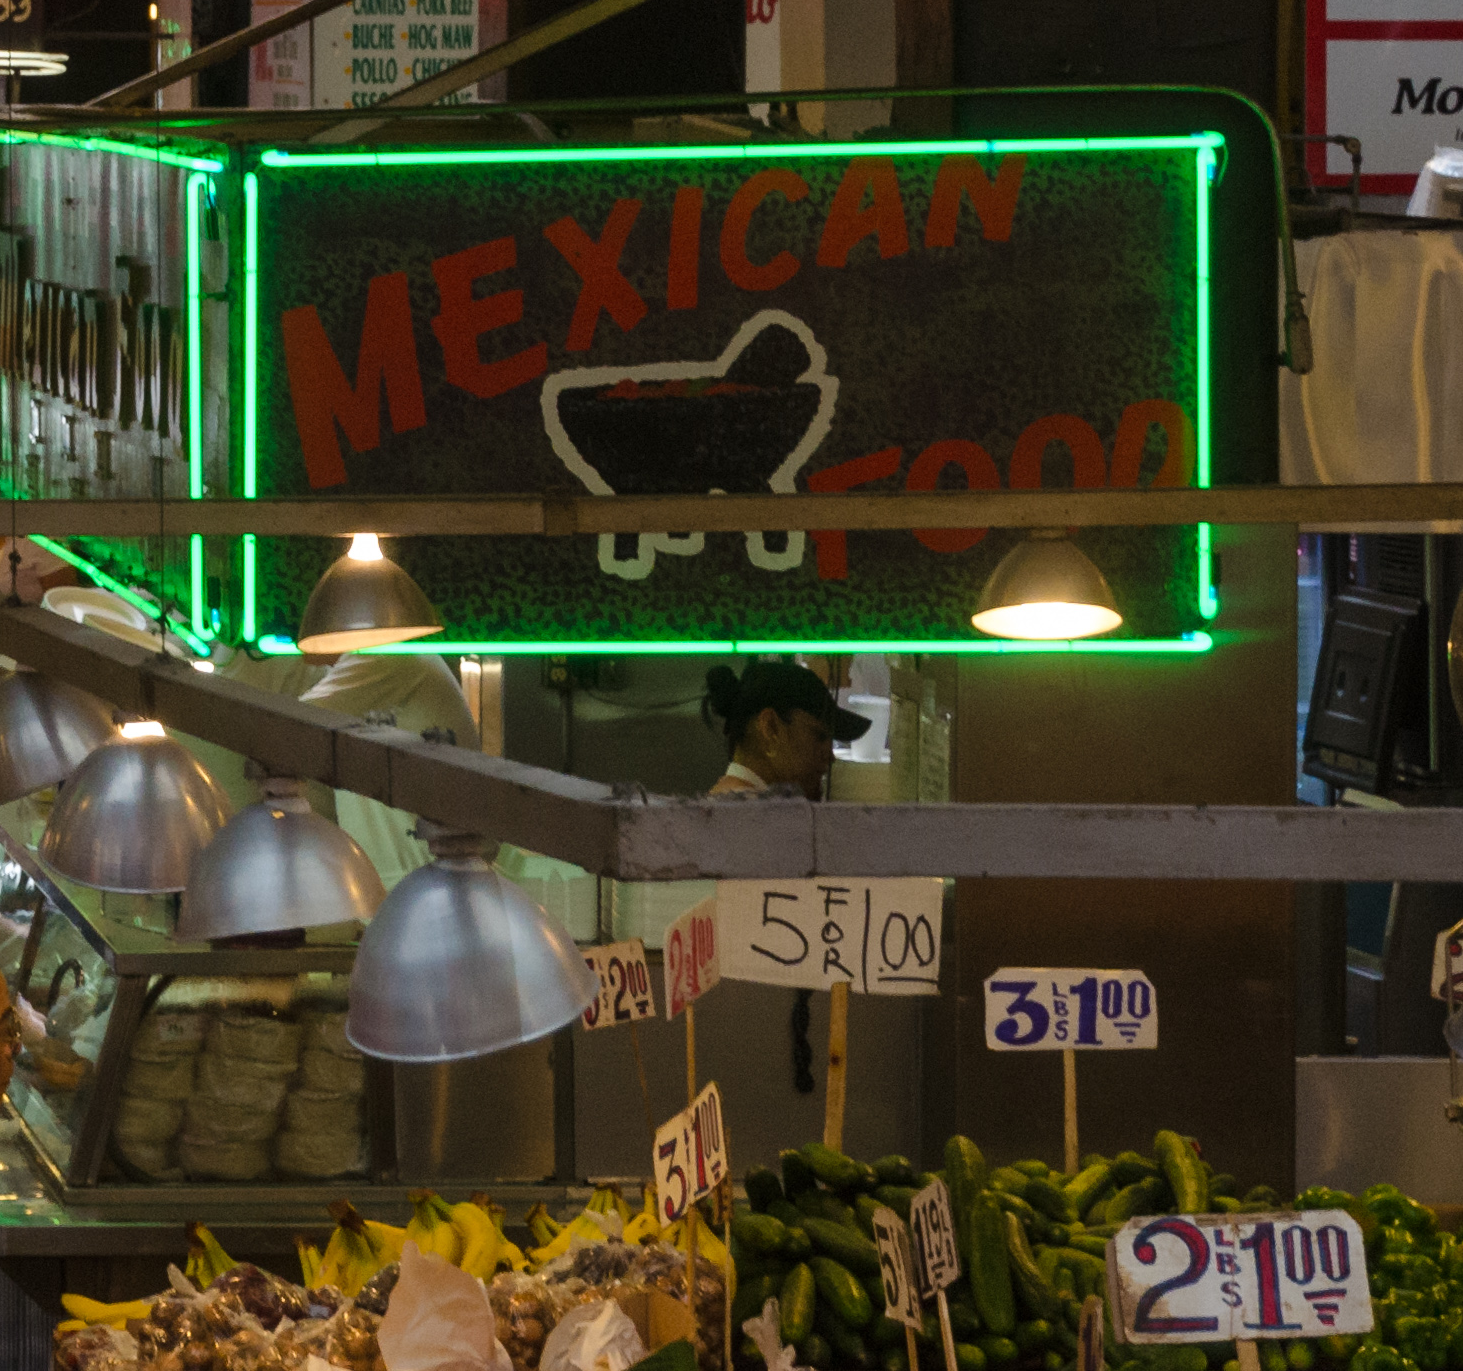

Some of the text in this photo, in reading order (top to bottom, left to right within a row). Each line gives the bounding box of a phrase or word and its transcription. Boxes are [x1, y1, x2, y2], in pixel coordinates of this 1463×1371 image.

[351, 23, 474, 50] BUCHE HOG MAW
[351, 57, 398, 84] POLLO
[281, 154, 1028, 490] MEXICAN
[808, 399, 1195, 580] FOOD
[750, 891, 809, 966] 5
[816, 885, 855, 978] FOR
[989, 981, 1050, 1046] 3
[1051, 981, 1069, 1042] LBS
[1132, 1216, 1219, 1334] 2
[1212, 1229, 1244, 1310] LBS
